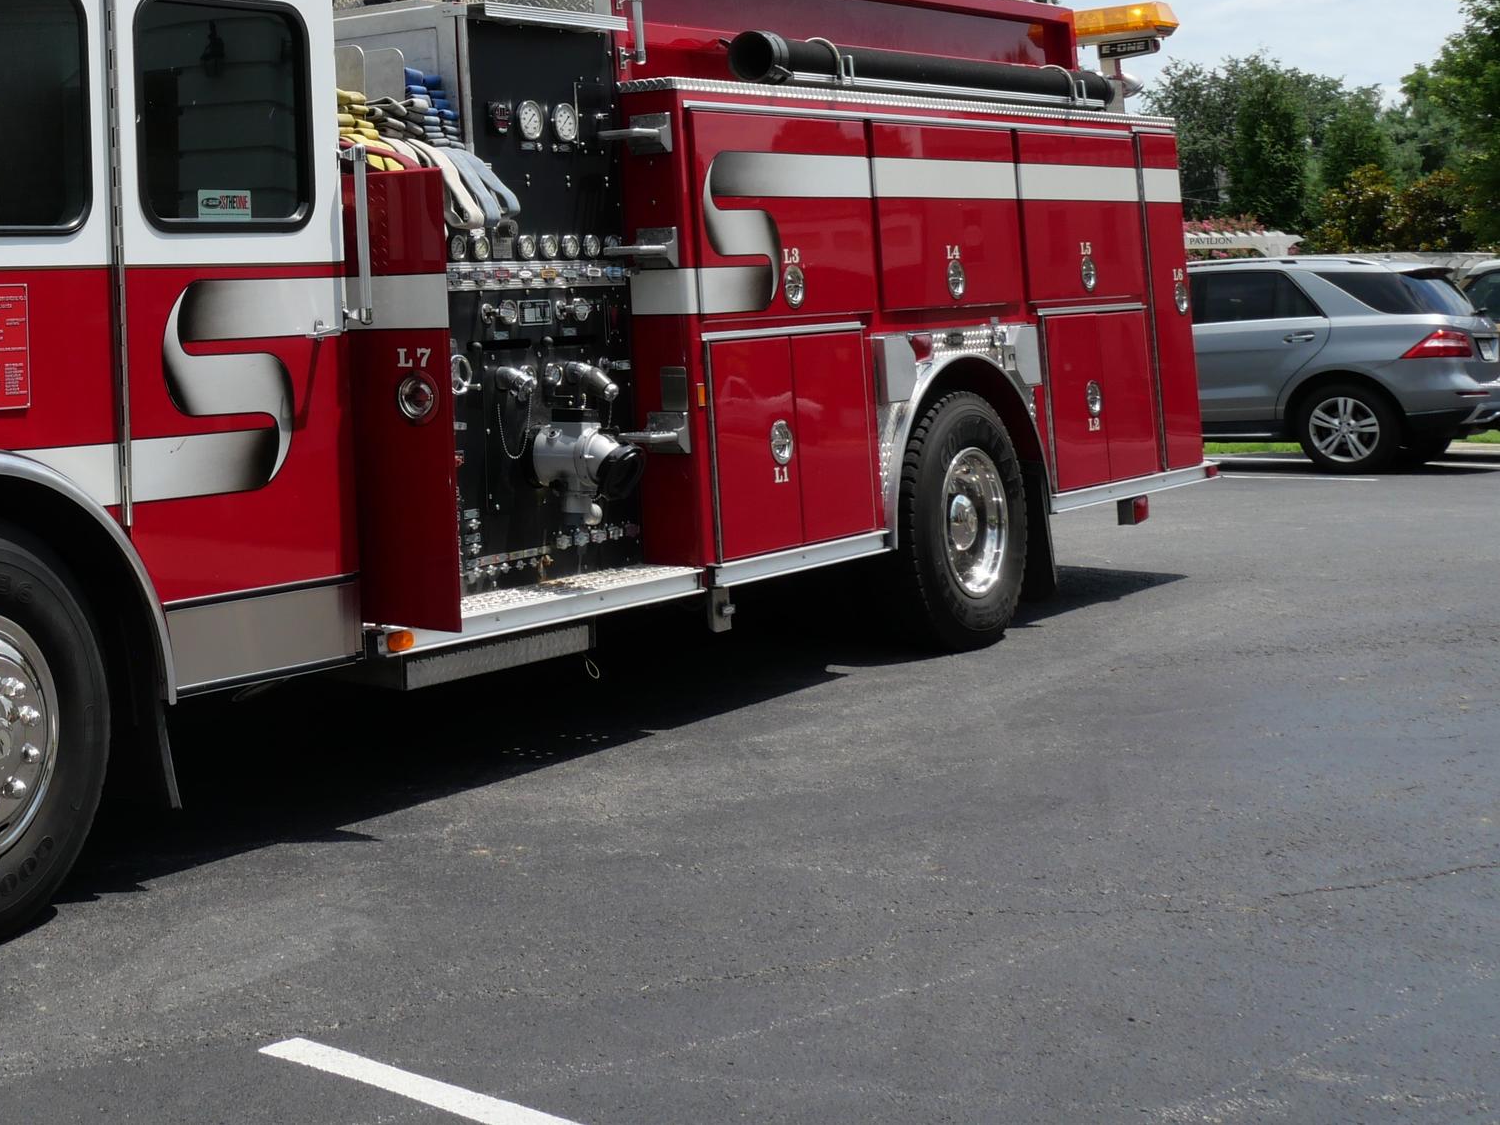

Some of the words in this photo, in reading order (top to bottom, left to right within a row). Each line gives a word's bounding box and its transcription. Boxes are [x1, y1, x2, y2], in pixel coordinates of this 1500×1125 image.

[1101, 41, 1145, 54] E-ONE
[1189, 237, 1232, 245] PAVILION
[946, 245, 960, 259] L4
[1080, 242, 1091, 255] L5
[783, 248, 800, 263] L3
[1173, 269, 1184, 281] L6
[1088, 418, 1100, 431] L2
[774, 466, 789, 483] L1
